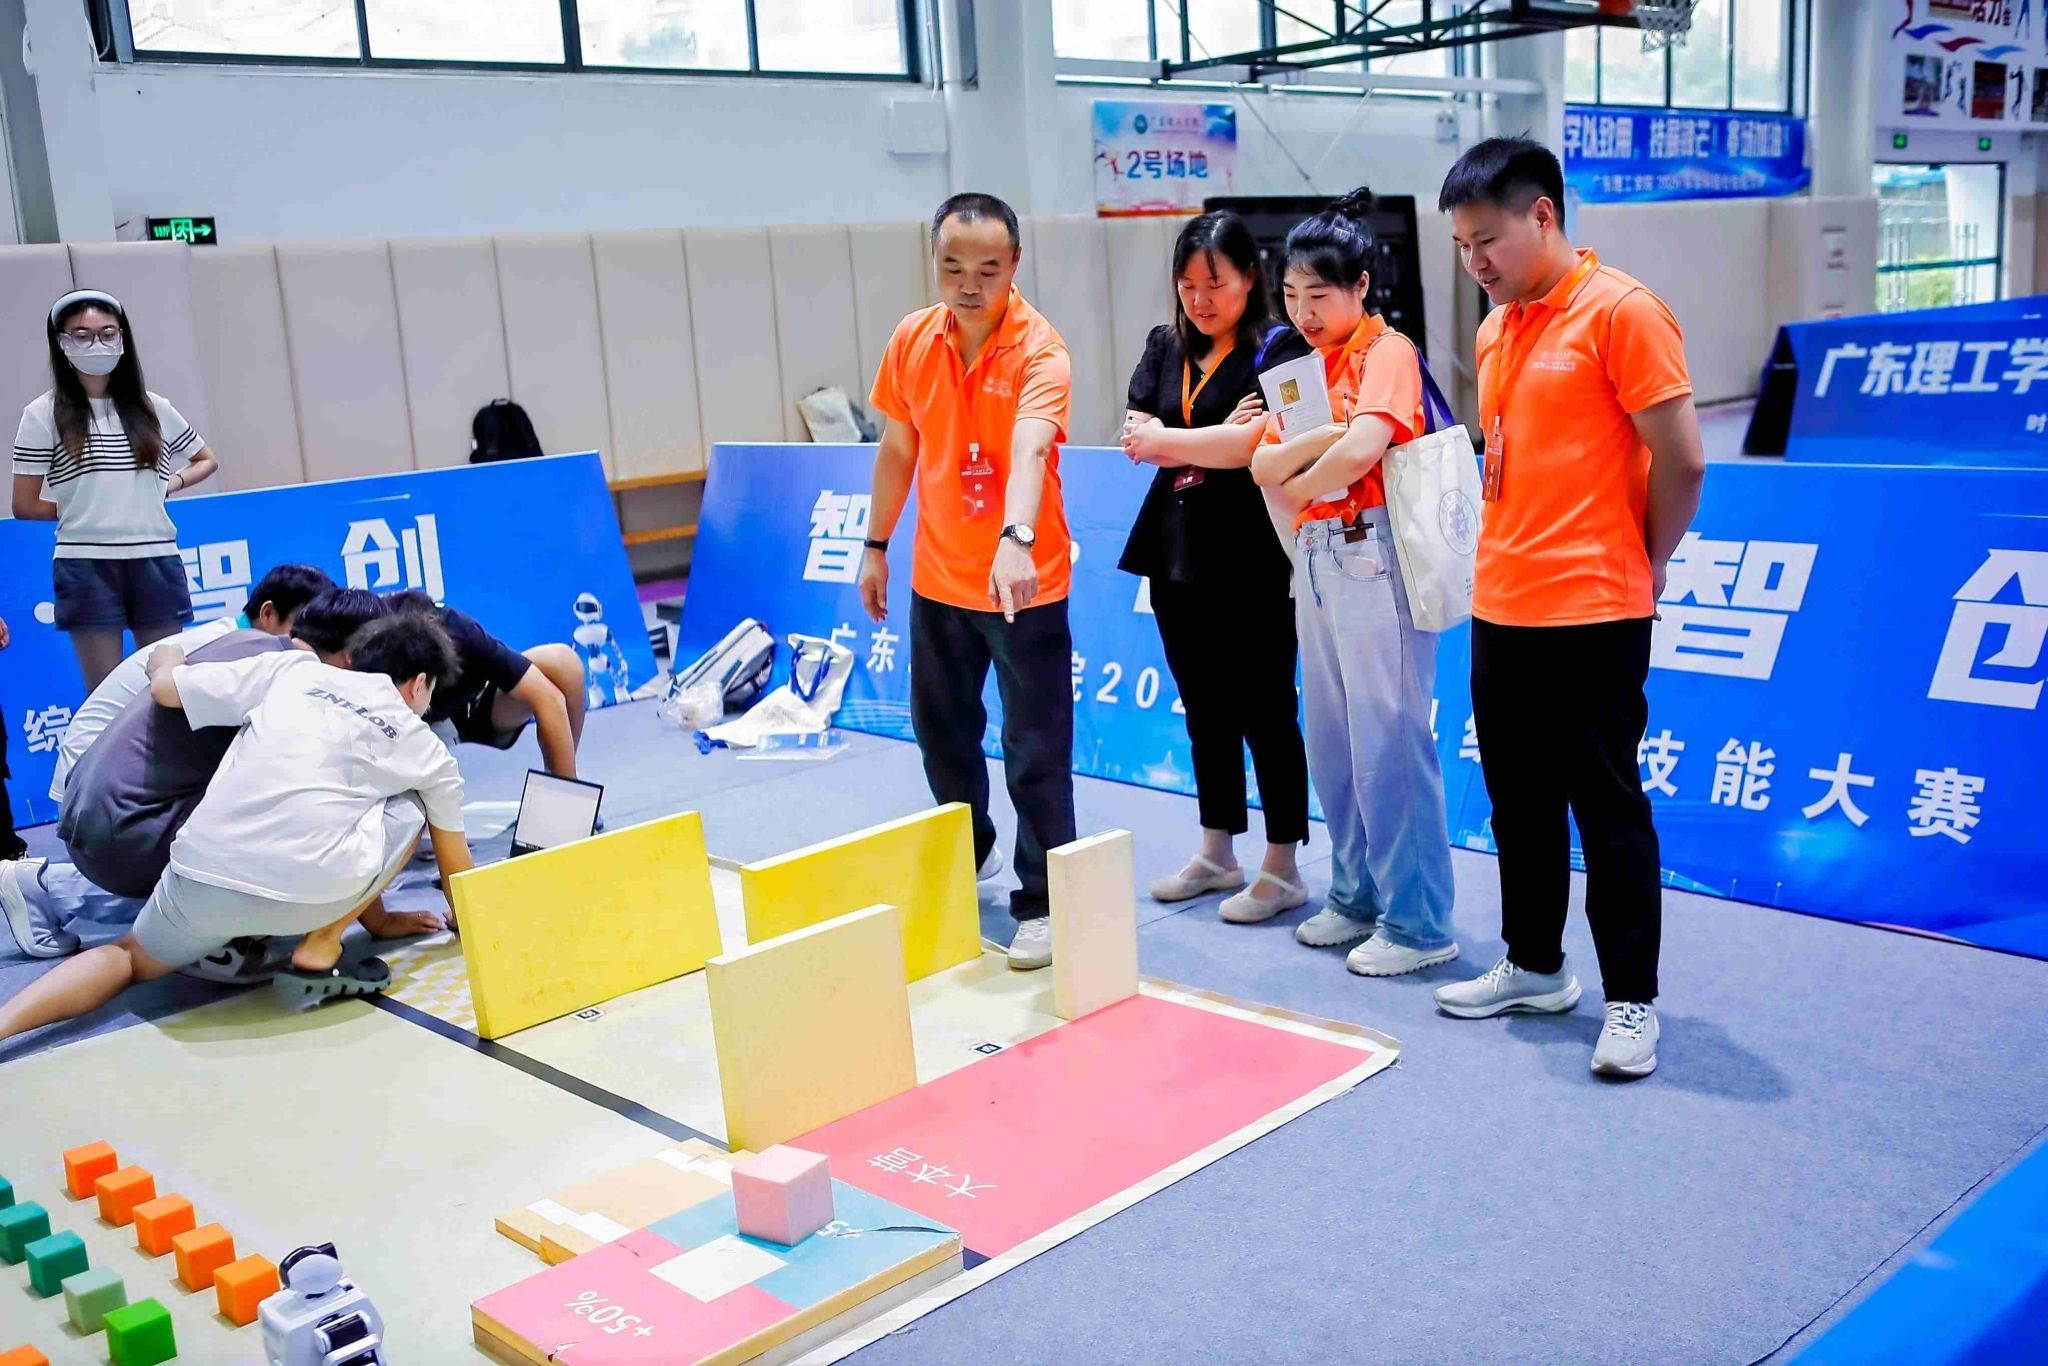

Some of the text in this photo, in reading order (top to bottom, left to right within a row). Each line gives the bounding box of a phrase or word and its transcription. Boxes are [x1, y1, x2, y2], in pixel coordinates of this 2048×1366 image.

[1126, 150, 1208, 178] 2号场地
[802, 489, 872, 584] 智
[866, 1147, 998, 1198] 大本营
[564, 1290, 654, 1338] +50%
